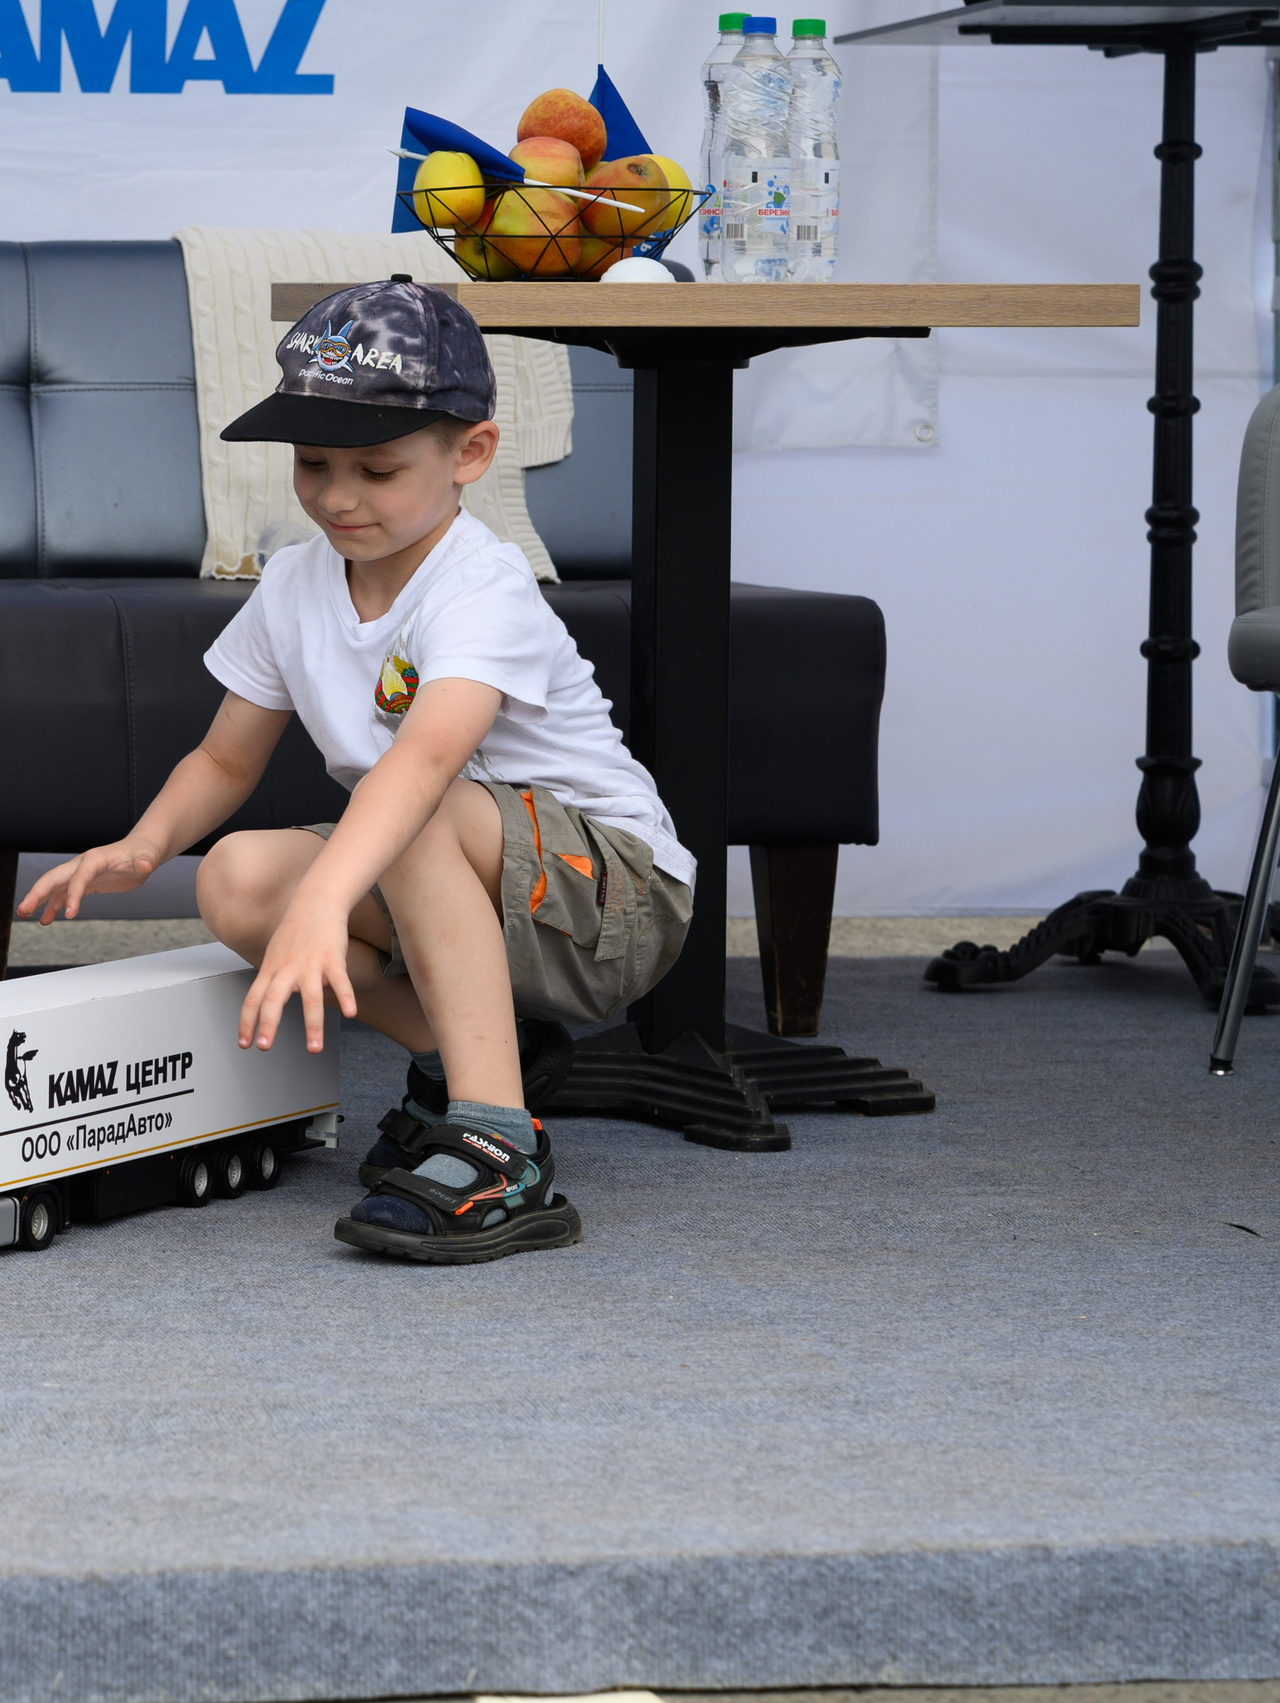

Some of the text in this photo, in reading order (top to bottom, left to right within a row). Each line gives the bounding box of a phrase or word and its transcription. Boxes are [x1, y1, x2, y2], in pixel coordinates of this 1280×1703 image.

[325, 373, 354, 385] Ocean
[350, 343, 402, 375] AREA
[48, 1051, 193, 1109] KAMAZ ЦЕНТР
[21, 1112, 173, 1163] ООО «ПарадАвто»
